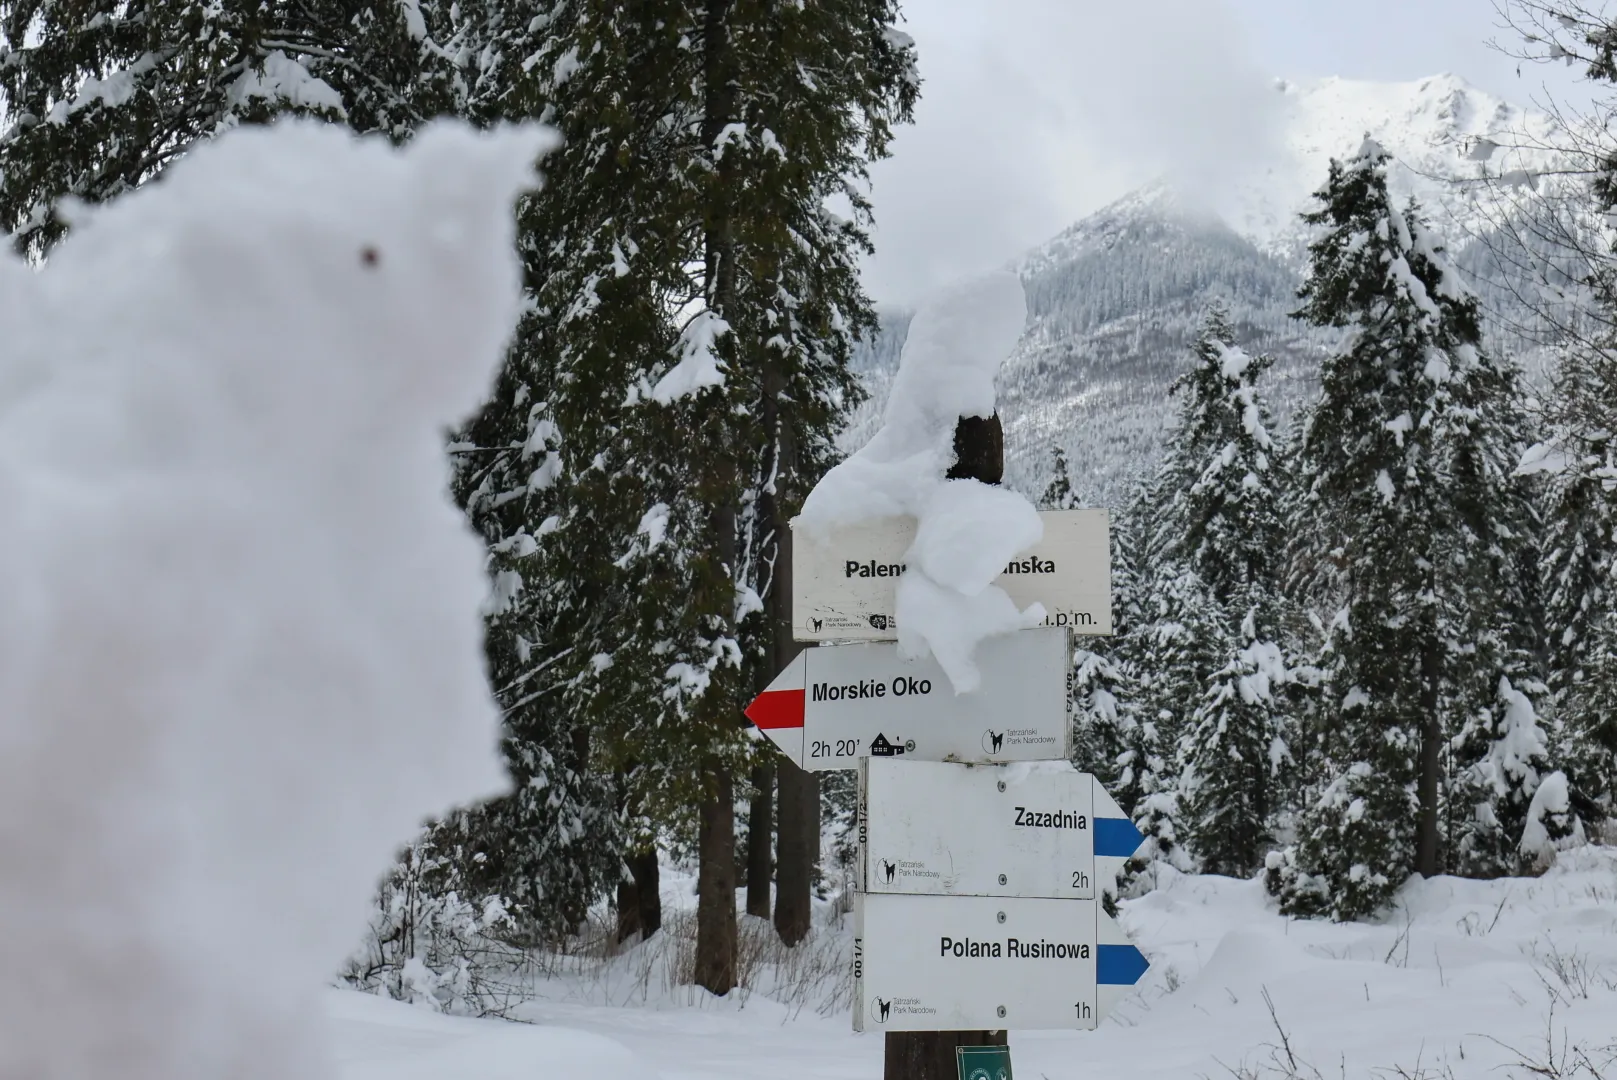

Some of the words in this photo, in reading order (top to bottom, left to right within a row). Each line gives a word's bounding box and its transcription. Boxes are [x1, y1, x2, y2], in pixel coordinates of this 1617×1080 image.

[812, 679, 886, 702] Morskie
[892, 676, 932, 697] Oko
[1006, 728, 1037, 736] Tatrzański
[1023, 736, 1056, 744] Narodowy
[811, 740, 831, 758] 2h
[859, 803, 868, 843] 001/2
[1014, 806, 1087, 830] Zazadnia
[898, 859, 925, 868] Tatrzański
[898, 869, 911, 877] Park
[912, 869, 941, 879] Narodowy
[1072, 871, 1089, 889] 2h
[940, 936, 1001, 958] Polana
[1007, 938, 1090, 959] Rusinowa
[854, 937, 863, 979] 001/1
[893, 997, 920, 1005] Tatrzański
[1074, 1001, 1092, 1019] 1h
[893, 1006, 907, 1014] Park
[908, 1006, 937, 1015] Narodowy
